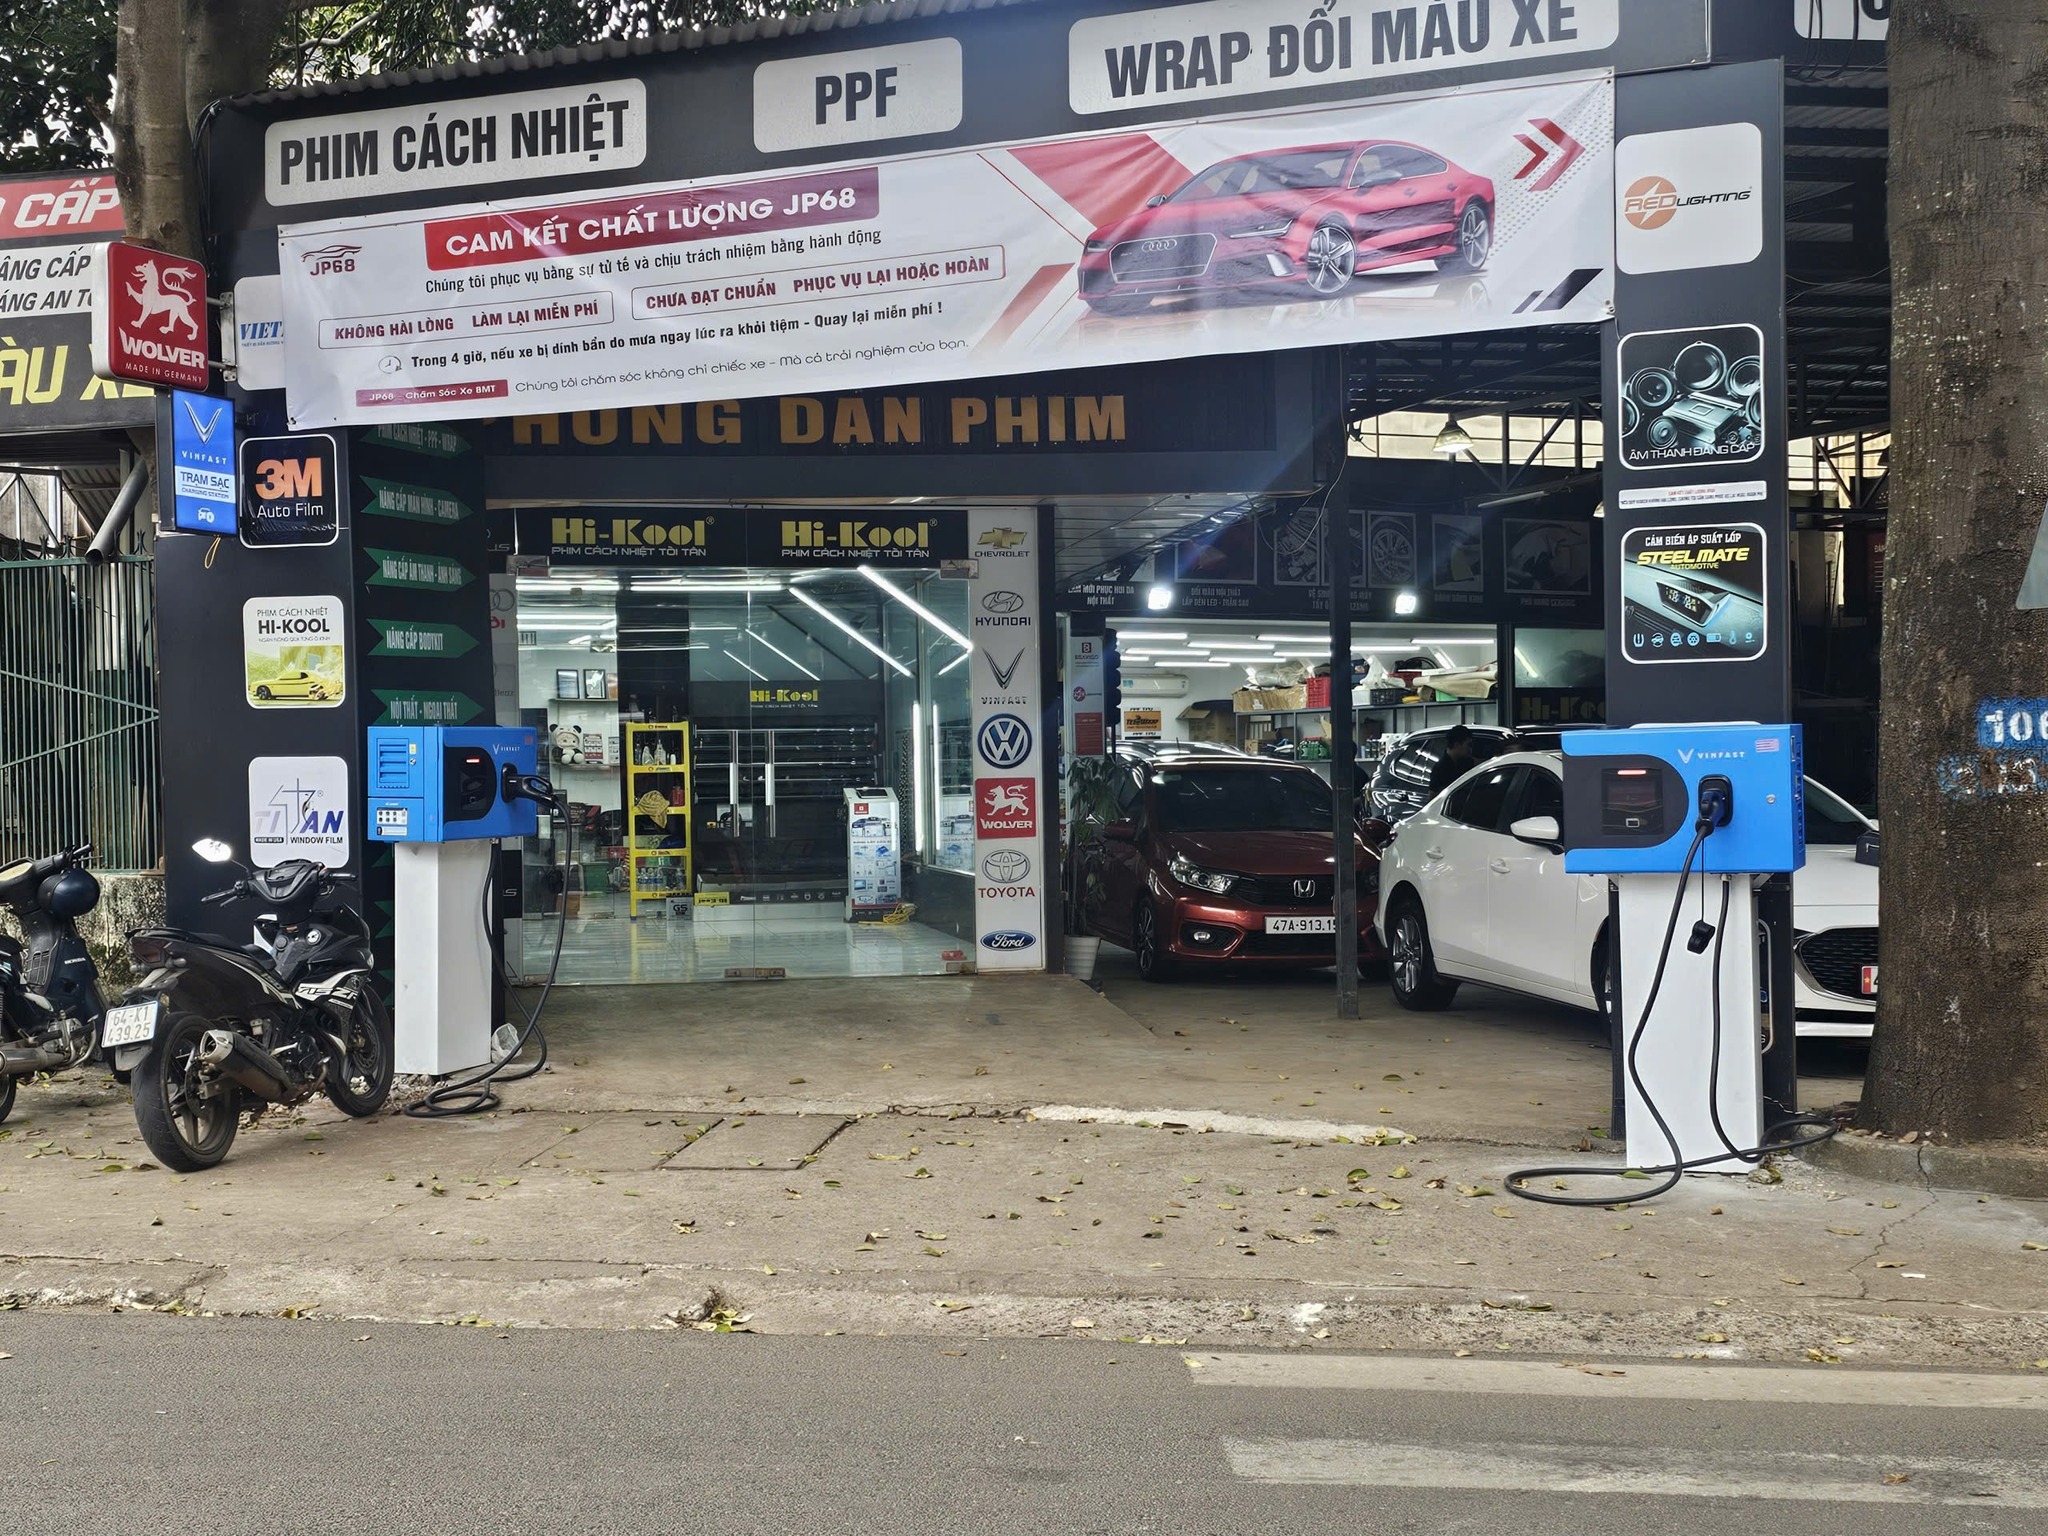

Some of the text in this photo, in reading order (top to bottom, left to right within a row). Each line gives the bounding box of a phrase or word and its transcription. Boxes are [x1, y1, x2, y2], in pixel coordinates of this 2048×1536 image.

[1105, 31, 1250, 98] WRAP
[816, 67, 898, 125] PPF
[280, 93, 630, 185] PHIM CÁCH NHIỆT
[14, 177, 120, 229] CẤP
[446, 188, 856, 255] CAM KẾT CHẤT LƯỢNG JP68
[45, 246, 92, 278] CẤP
[310, 259, 355, 276] JP68
[426, 229, 882, 293] Chúng tôi phục vụ bằng sự tử tế và chịu trách nhiệm bằng hành động
[646, 256, 989, 310] CHƯA ĐẠT CHUẨN PHỤC VỤ LẠI HOẶC HOÀN
[39, 288, 92, 310] AN T
[241, 321, 284, 340] VIET
[335, 299, 598, 340] KHÔNG HÀI LÒNG LÀM LẠI MIỄN PHÍ
[411, 302, 933, 368] Trong 4 giờ, nếu xe bị dính bẩn do mưa ngay lúc ra khỏi tiệm Quay lại miễn phí
[119, 327, 206, 369] WOLVER
[125, 362, 203, 384] MADE IN GERMANY
[515, 379, 559, 392] Chúng
[561, 376, 578, 388] tôi
[619, 371, 642, 383] sóc
[644, 367, 685, 380] không
[688, 361, 708, 376] chỉ
[711, 359, 747, 373] chiếc
[750, 359, 766, 370] xe
[780, 355, 802, 367] Mà
[805, 350, 823, 364] cả
[825, 348, 852, 362] trải
[855, 343, 905, 360] nghiệm
[908, 340, 935, 353] của
[939, 338, 970, 350] bạn.
[369, 393, 394, 402] JP68
[438, 388, 457, 397] Sóc
[460, 388, 473, 396] Xe
[951, 395, 1126, 444] PHIM
[181, 450, 227, 465] VINFAST
[180, 471, 230, 491] TRẠM SẠC
[255, 457, 323, 500] 3M
[256, 503, 323, 518] Auto Film
[551, 517, 706, 546] Hi-Kool
[781, 520, 929, 547] Hi-Kool
[552, 545, 707, 558] PHIM CÁCH NHIỆT TÂN
[782, 548, 930, 560] PHIM CÁCH NHIỆT TÂN
[974, 550, 1031, 558] CHEVROLET
[257, 606, 328, 617] PHIM CÁCH NHIỆT
[975, 616, 1031, 626] HYUNDAI
[258, 618, 330, 634] HI-KOOL
[1697, 752, 1746, 760] VINFAST
[980, 817, 1033, 830] WOLVER
[290, 836, 344, 844] WINDOW FILM
[978, 886, 1035, 899] TOYOTA
[991, 932, 1025, 949] Ford
